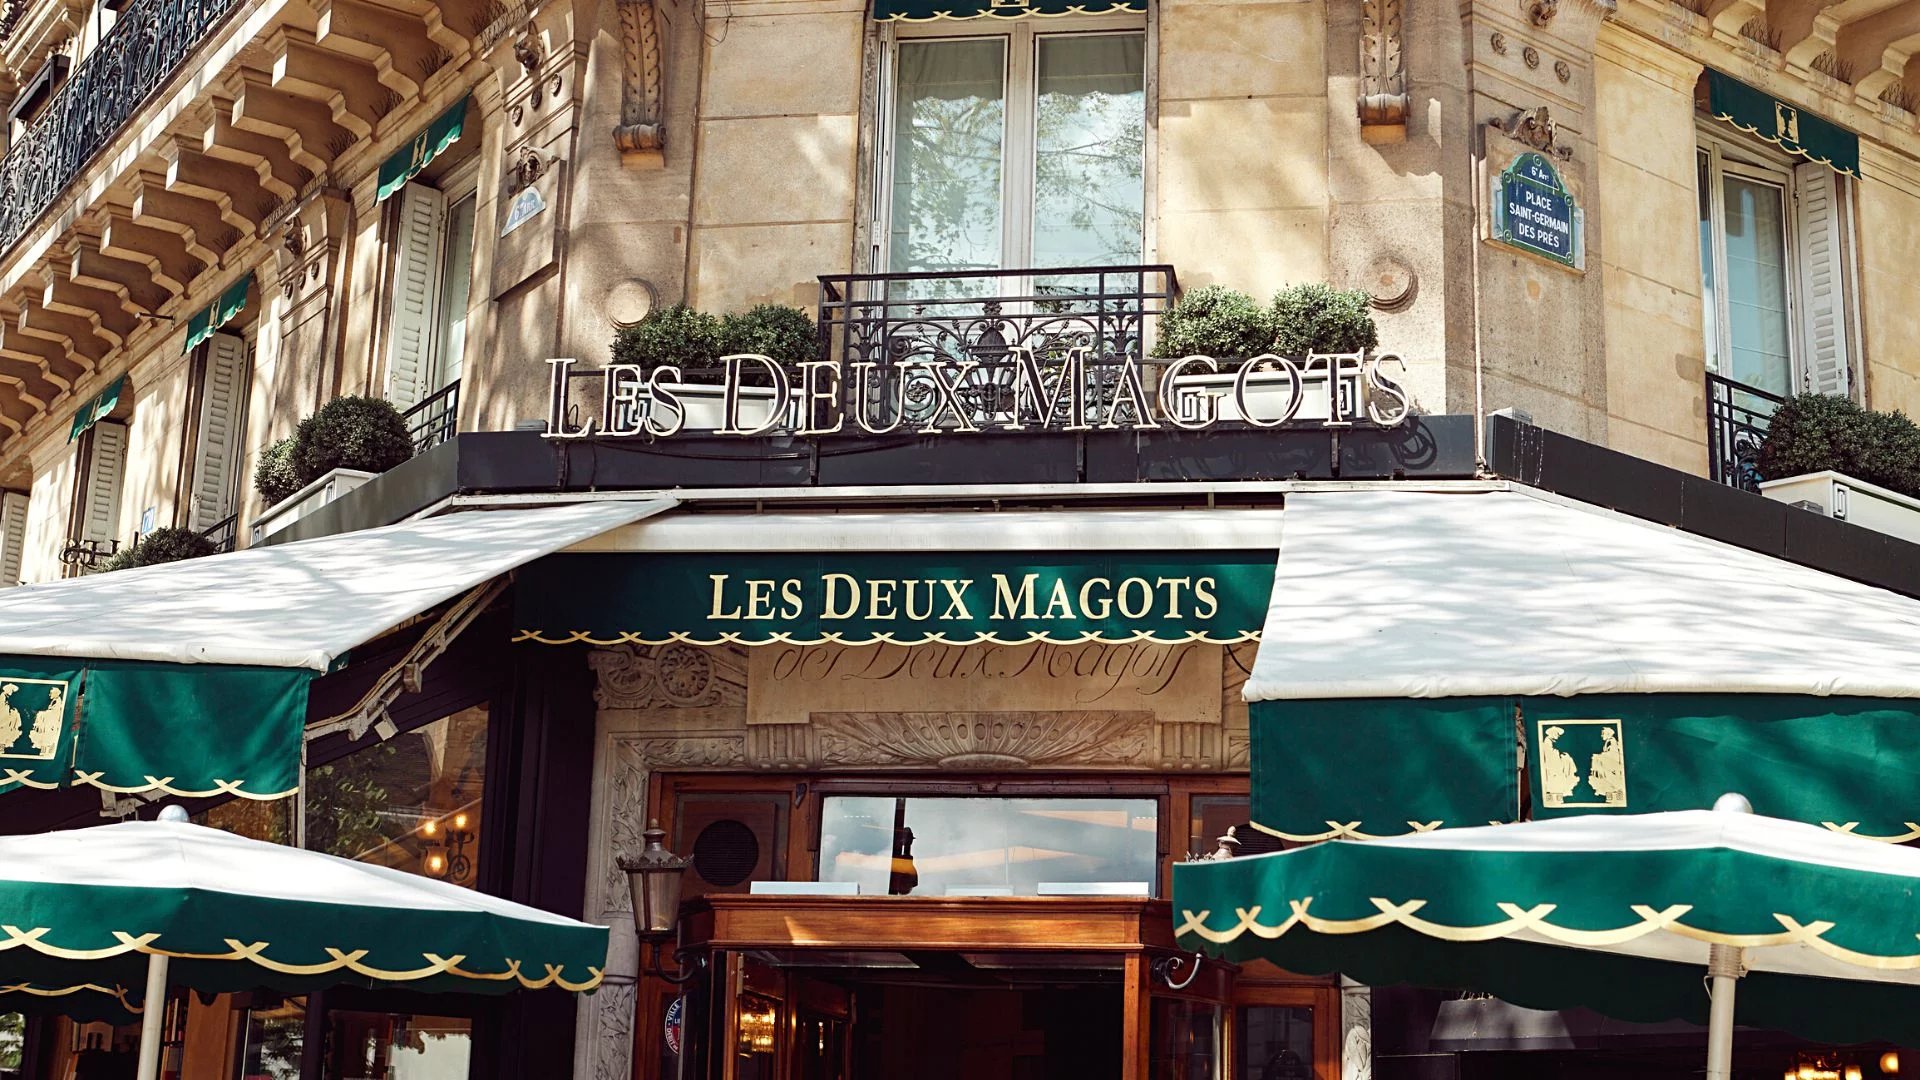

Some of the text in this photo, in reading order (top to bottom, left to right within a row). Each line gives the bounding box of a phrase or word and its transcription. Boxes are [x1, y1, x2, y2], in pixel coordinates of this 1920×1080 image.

[1509, 202, 1569, 235] SAINT-GERMAIN
[1525, 191, 1552, 211] PLACE
[1518, 222, 1560, 248] DES PRÉS
[540, 346, 1410, 438] LES DEUX MAGOTS
[707, 572, 1219, 620] LES DEUX MAGOTS
[840, 641, 1000, 681] Deux
